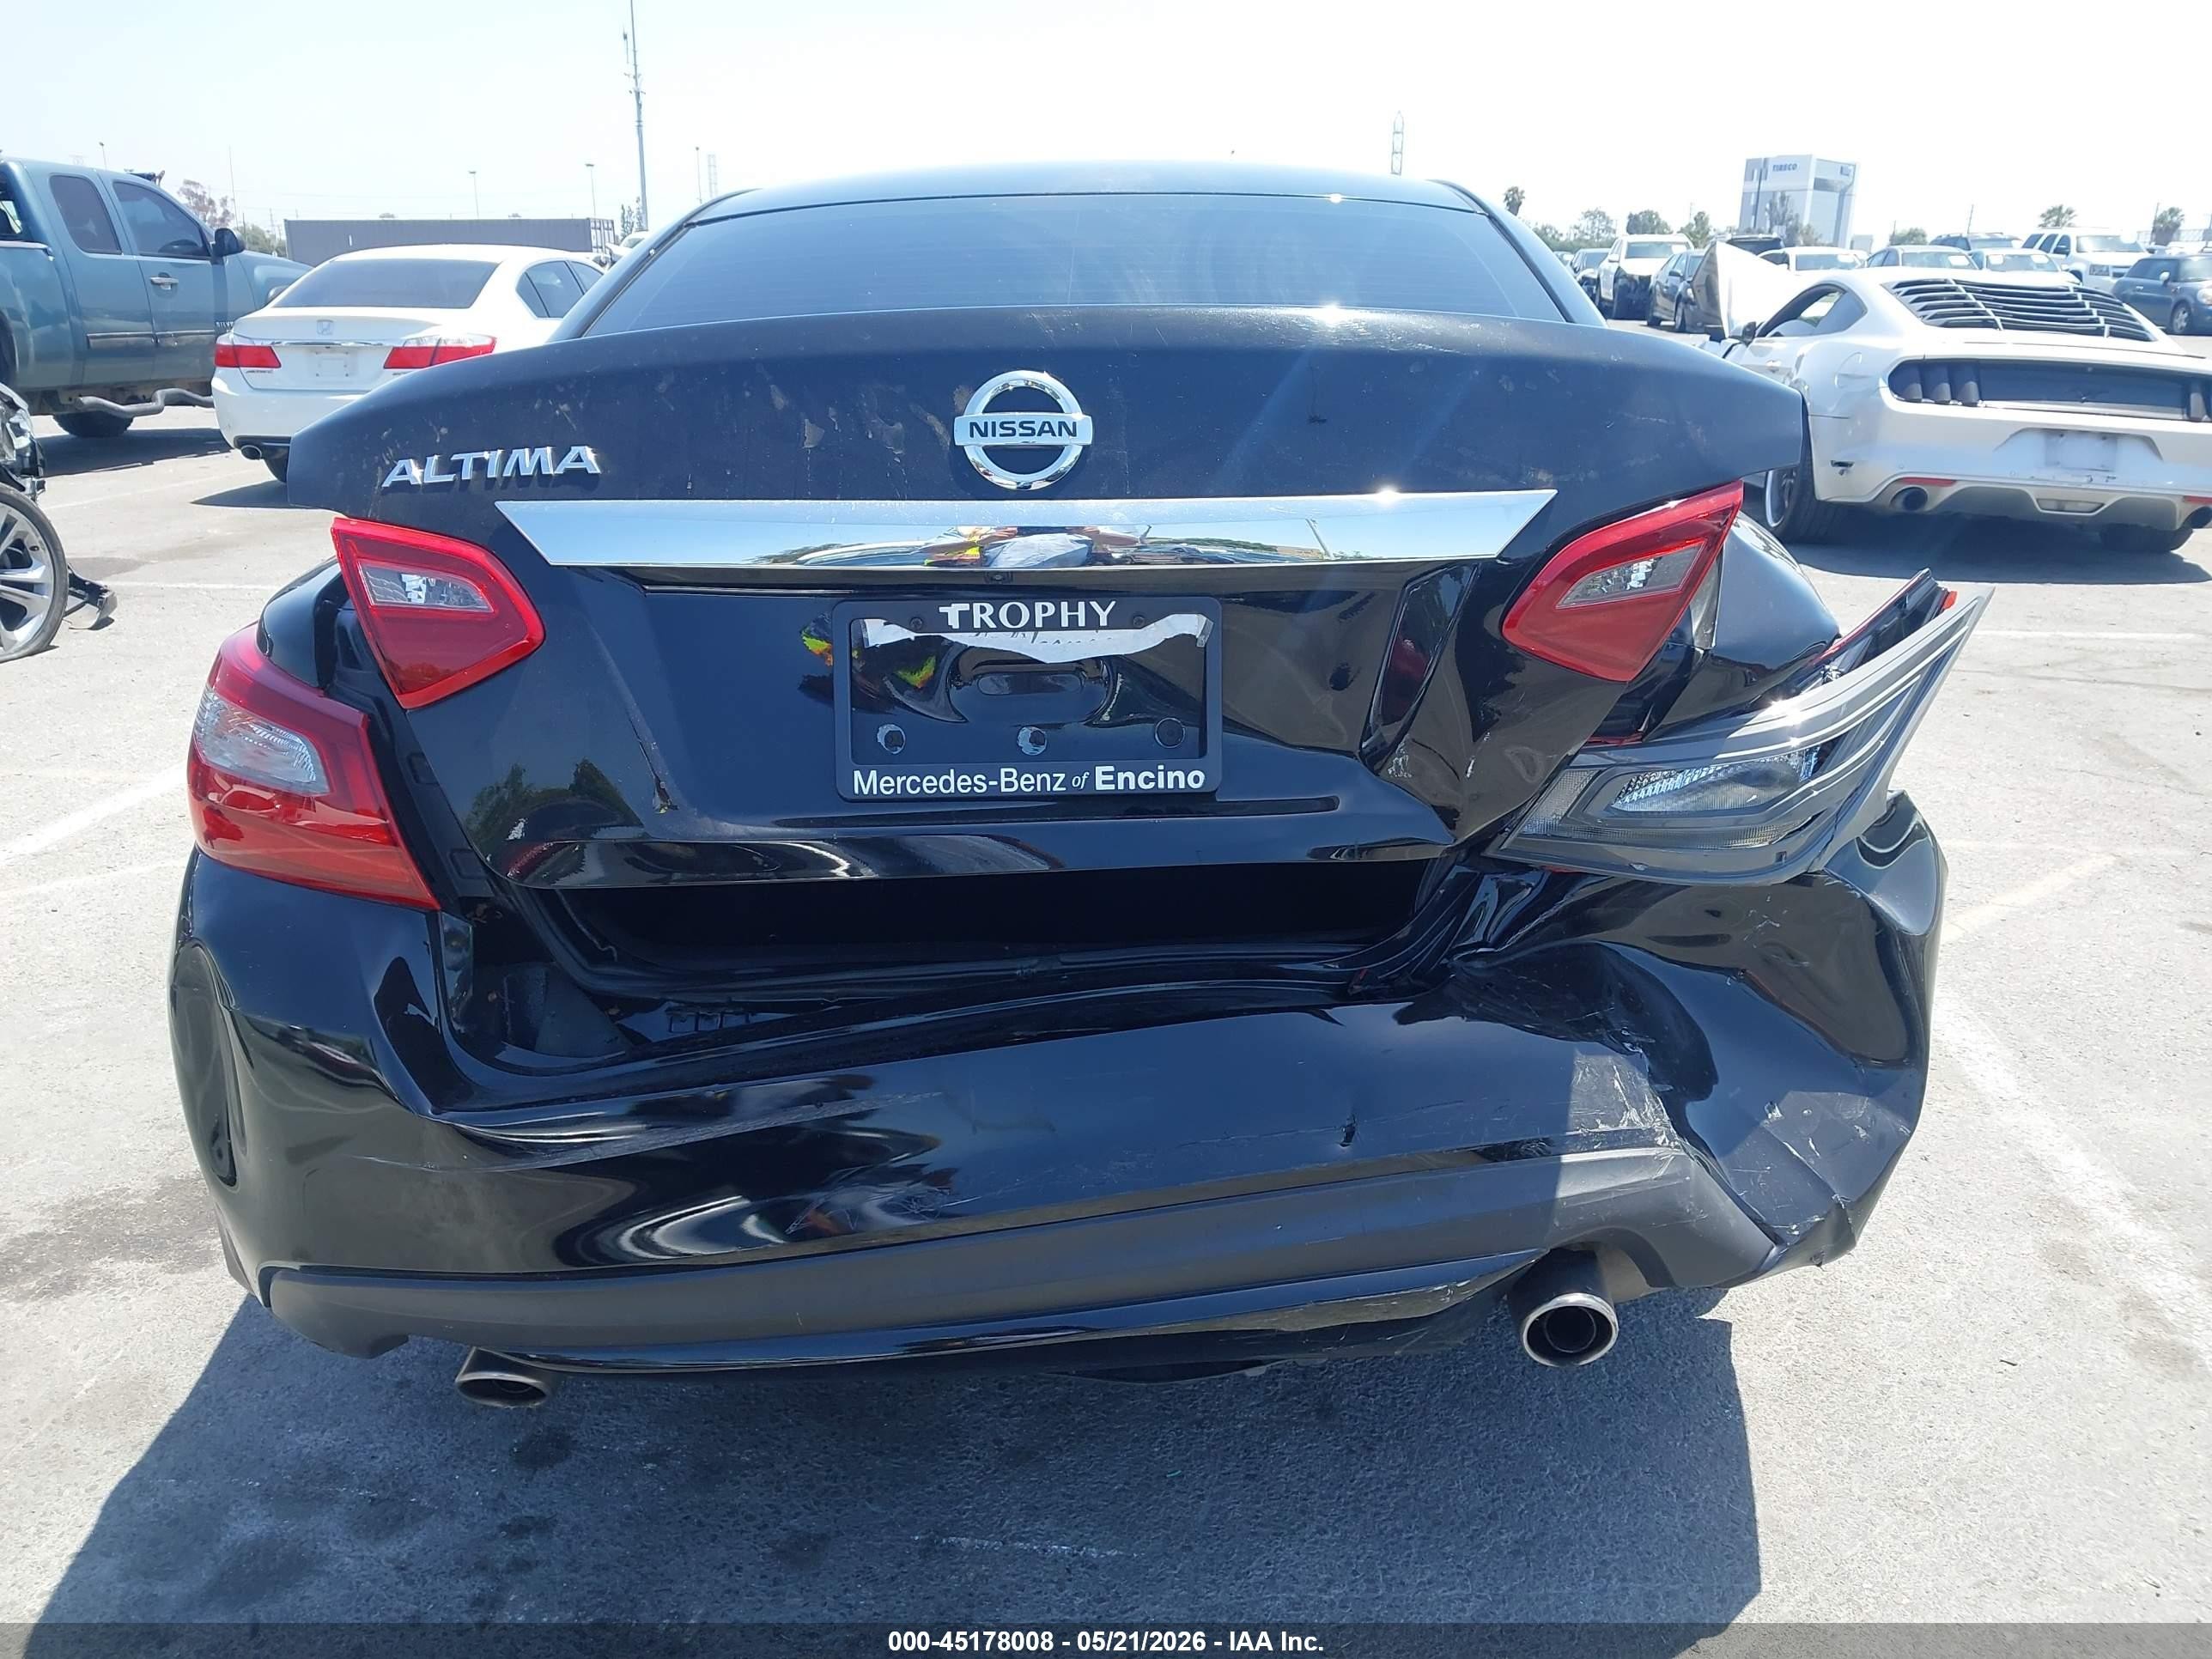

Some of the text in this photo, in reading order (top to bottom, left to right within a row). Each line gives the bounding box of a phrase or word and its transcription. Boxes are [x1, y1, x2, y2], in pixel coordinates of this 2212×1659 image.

[969, 421, 1077, 438] NISSAN
[381, 445, 602, 488] ALTIMA
[939, 600, 1116, 629] TROPHY
[854, 765, 1206, 795] Mercedes-Benz of Encino
